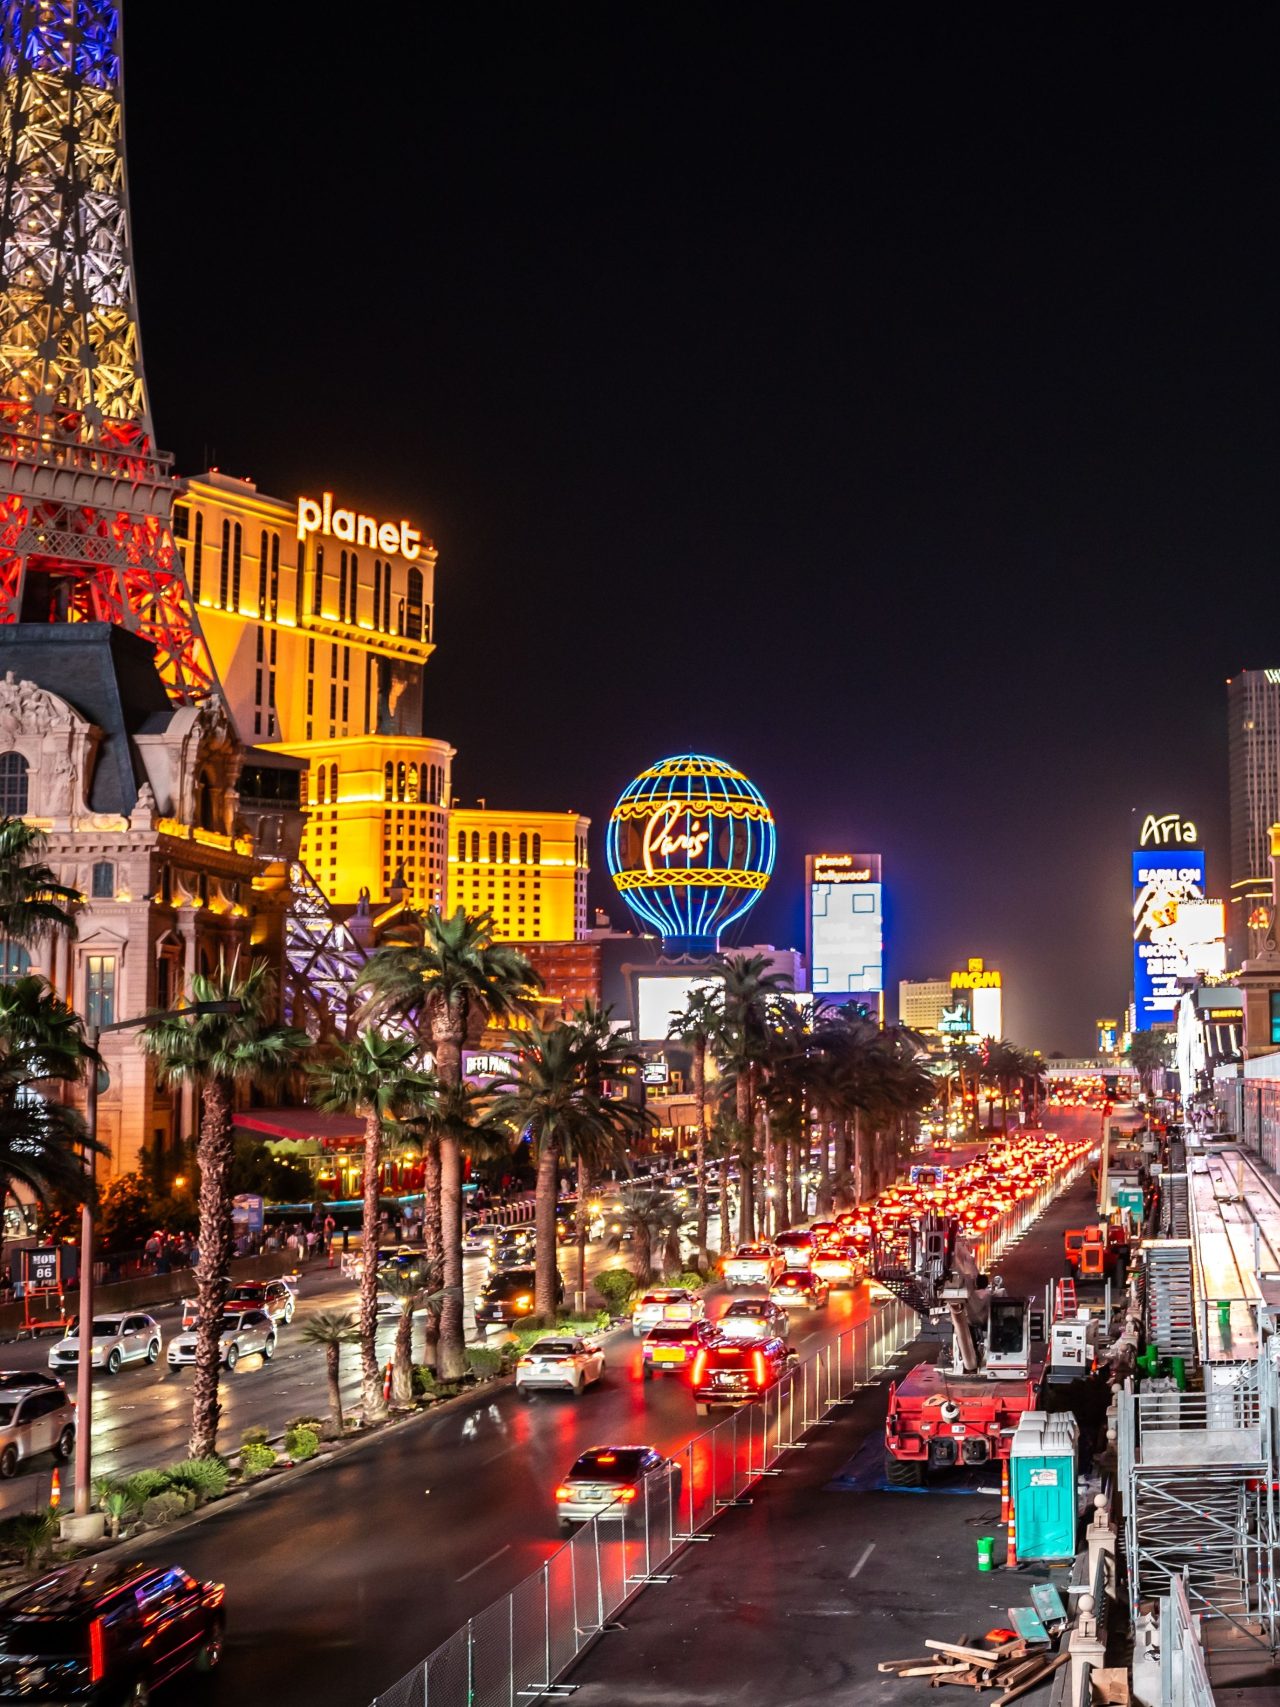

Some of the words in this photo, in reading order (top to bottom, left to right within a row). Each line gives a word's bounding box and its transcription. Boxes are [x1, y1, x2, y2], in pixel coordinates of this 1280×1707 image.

[297, 491, 421, 560] planet
[643, 800, 709, 877] Paris
[1140, 814, 1197, 846] Aria
[815, 855, 852, 868] planet
[815, 869, 870, 883] hollywood
[950, 971, 1001, 988] MGM
[32, 1254, 56, 1264] MOB
